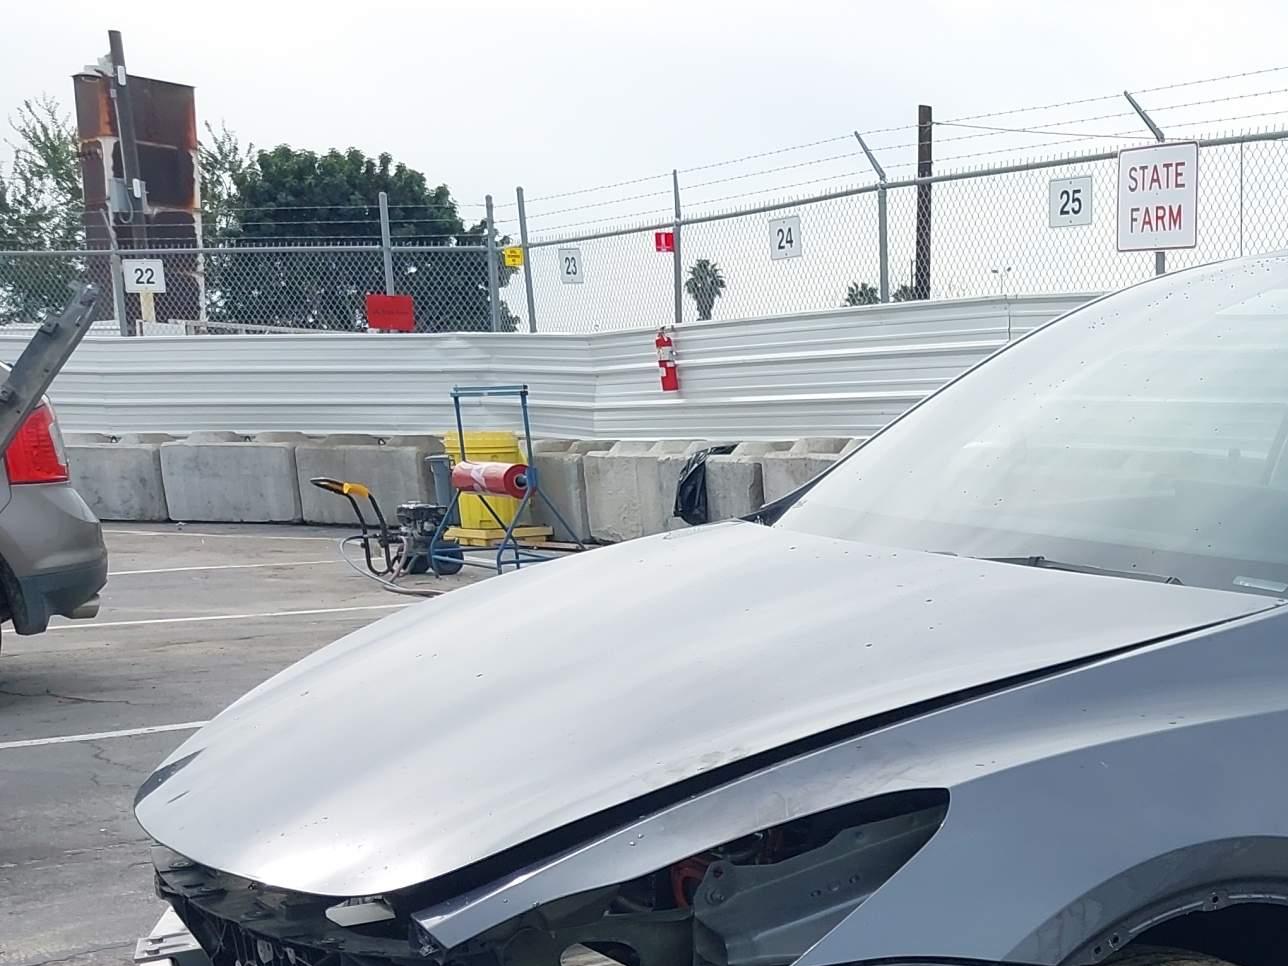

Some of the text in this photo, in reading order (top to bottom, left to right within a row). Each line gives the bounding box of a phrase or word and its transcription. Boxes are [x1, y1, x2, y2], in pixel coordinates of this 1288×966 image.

[1128, 162, 1186, 193] STATE
[1060, 189, 1082, 216] 25
[1130, 204, 1182, 233] FARM
[777, 227, 793, 250] 24
[134, 267, 155, 285] 22
[564, 256, 577, 275] 23
